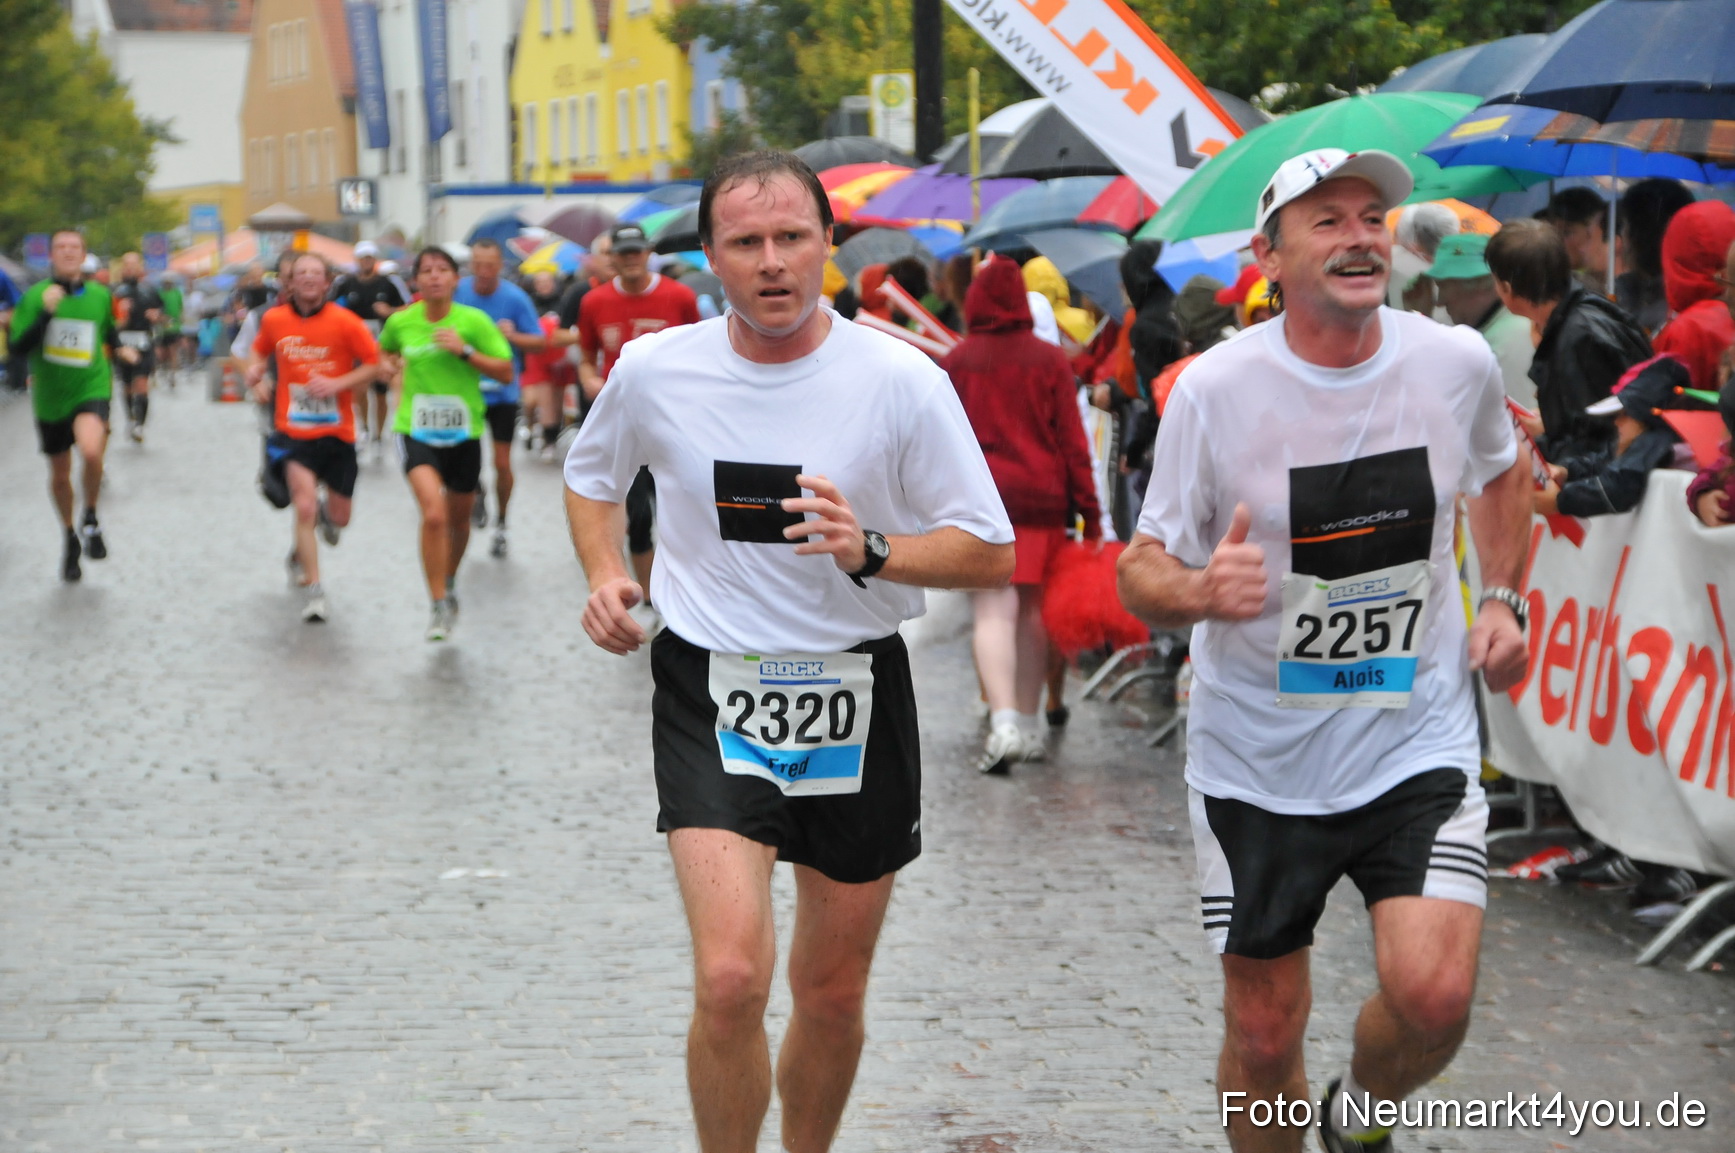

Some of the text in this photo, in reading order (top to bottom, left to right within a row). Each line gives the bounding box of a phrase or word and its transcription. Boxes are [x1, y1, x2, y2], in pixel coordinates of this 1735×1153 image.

[1328, 577, 1390, 600] BOCK
[1294, 599, 1423, 660] 2257
[760, 661, 824, 676] BOCK
[1333, 666, 1386, 689] Alois
[727, 690, 857, 745] 2320
[768, 756, 810, 777] Fred
